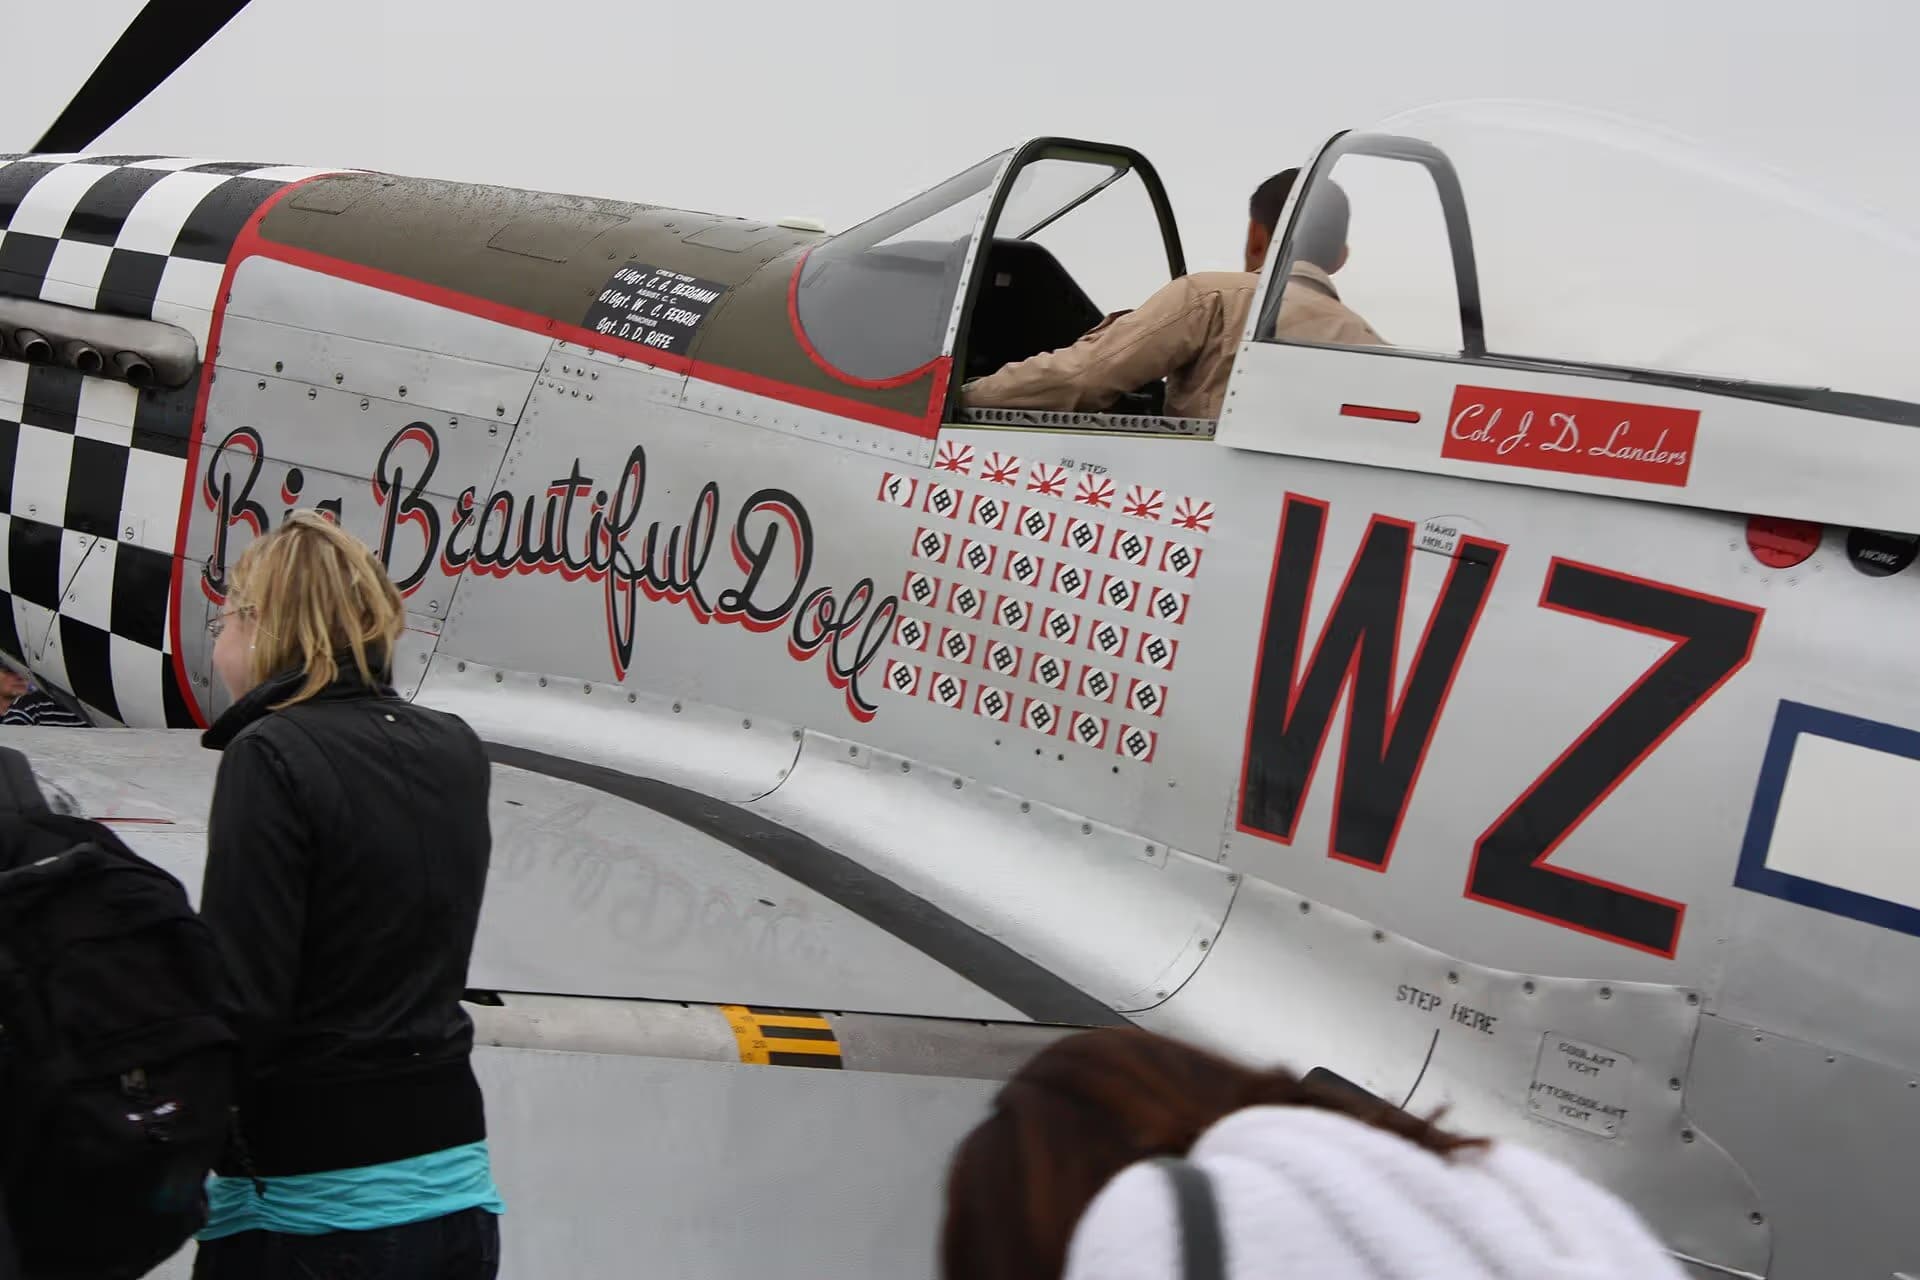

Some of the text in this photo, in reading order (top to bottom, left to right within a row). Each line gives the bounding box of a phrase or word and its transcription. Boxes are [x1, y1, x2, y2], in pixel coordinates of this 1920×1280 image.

[630, 297, 648, 313] W.
[662, 307, 701, 327] FERRIS
[671, 283, 720, 304] BERGMAN
[619, 323, 631, 338] D.
[632, 327, 644, 342] D.
[644, 331, 674, 349] RIFFE
[1450, 402, 1504, 444] Col.
[1587, 420, 1688, 467] Landers
[372, 421, 719, 682] Beautiful
[713, 488, 898, 723] Doll
[1396, 984, 1498, 1035] STEP HERE
